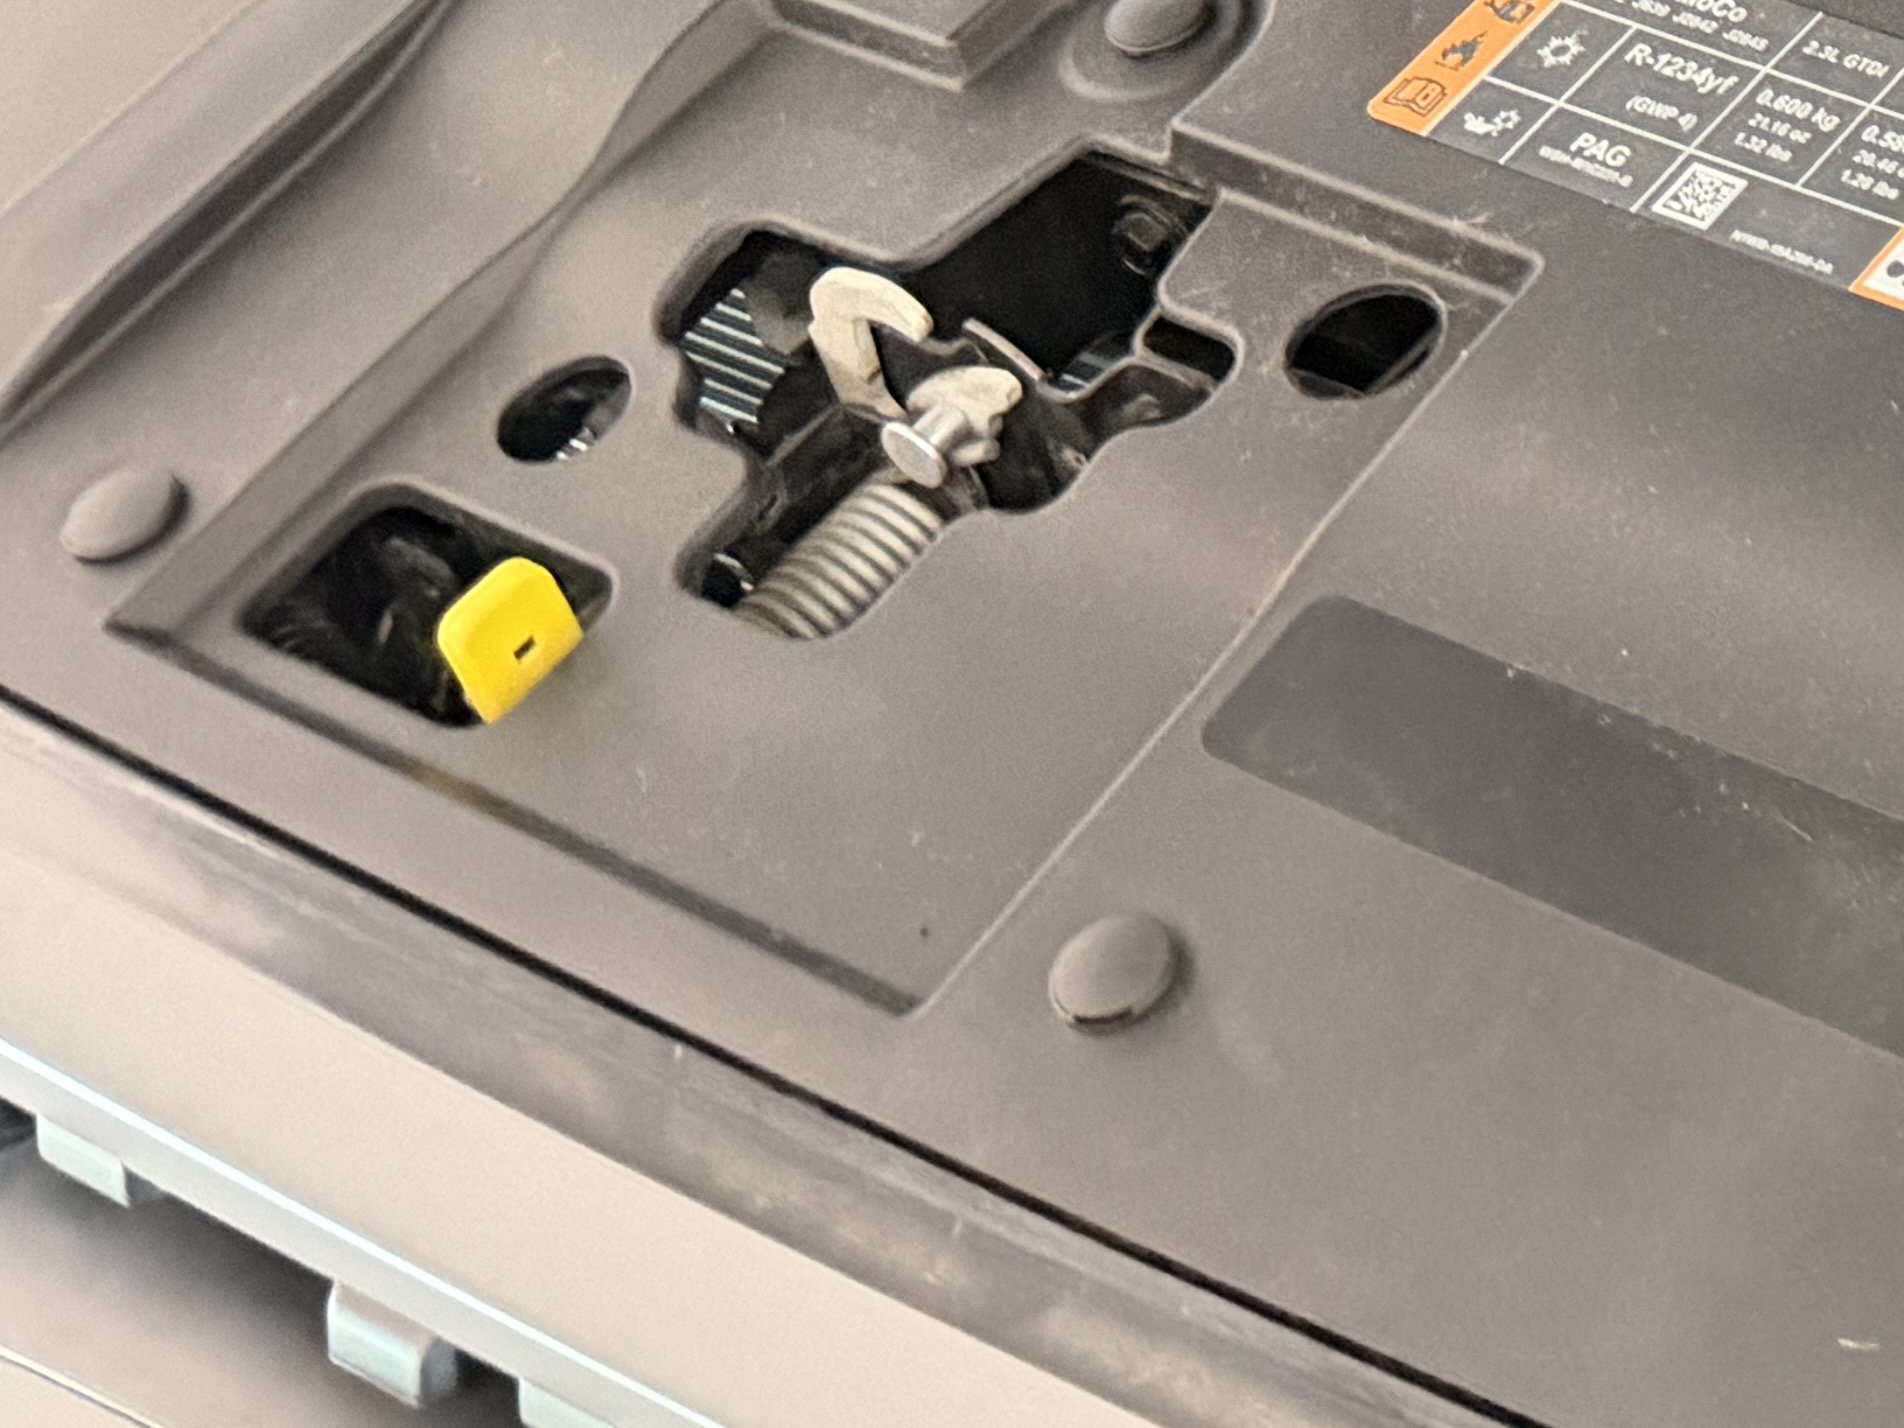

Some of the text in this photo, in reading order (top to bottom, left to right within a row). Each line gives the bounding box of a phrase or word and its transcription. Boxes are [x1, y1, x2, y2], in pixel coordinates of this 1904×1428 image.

[1624, 43, 1740, 94] R-1234yf
[1811, 106, 1841, 132] kg
[1569, 132, 1632, 167] PAG
